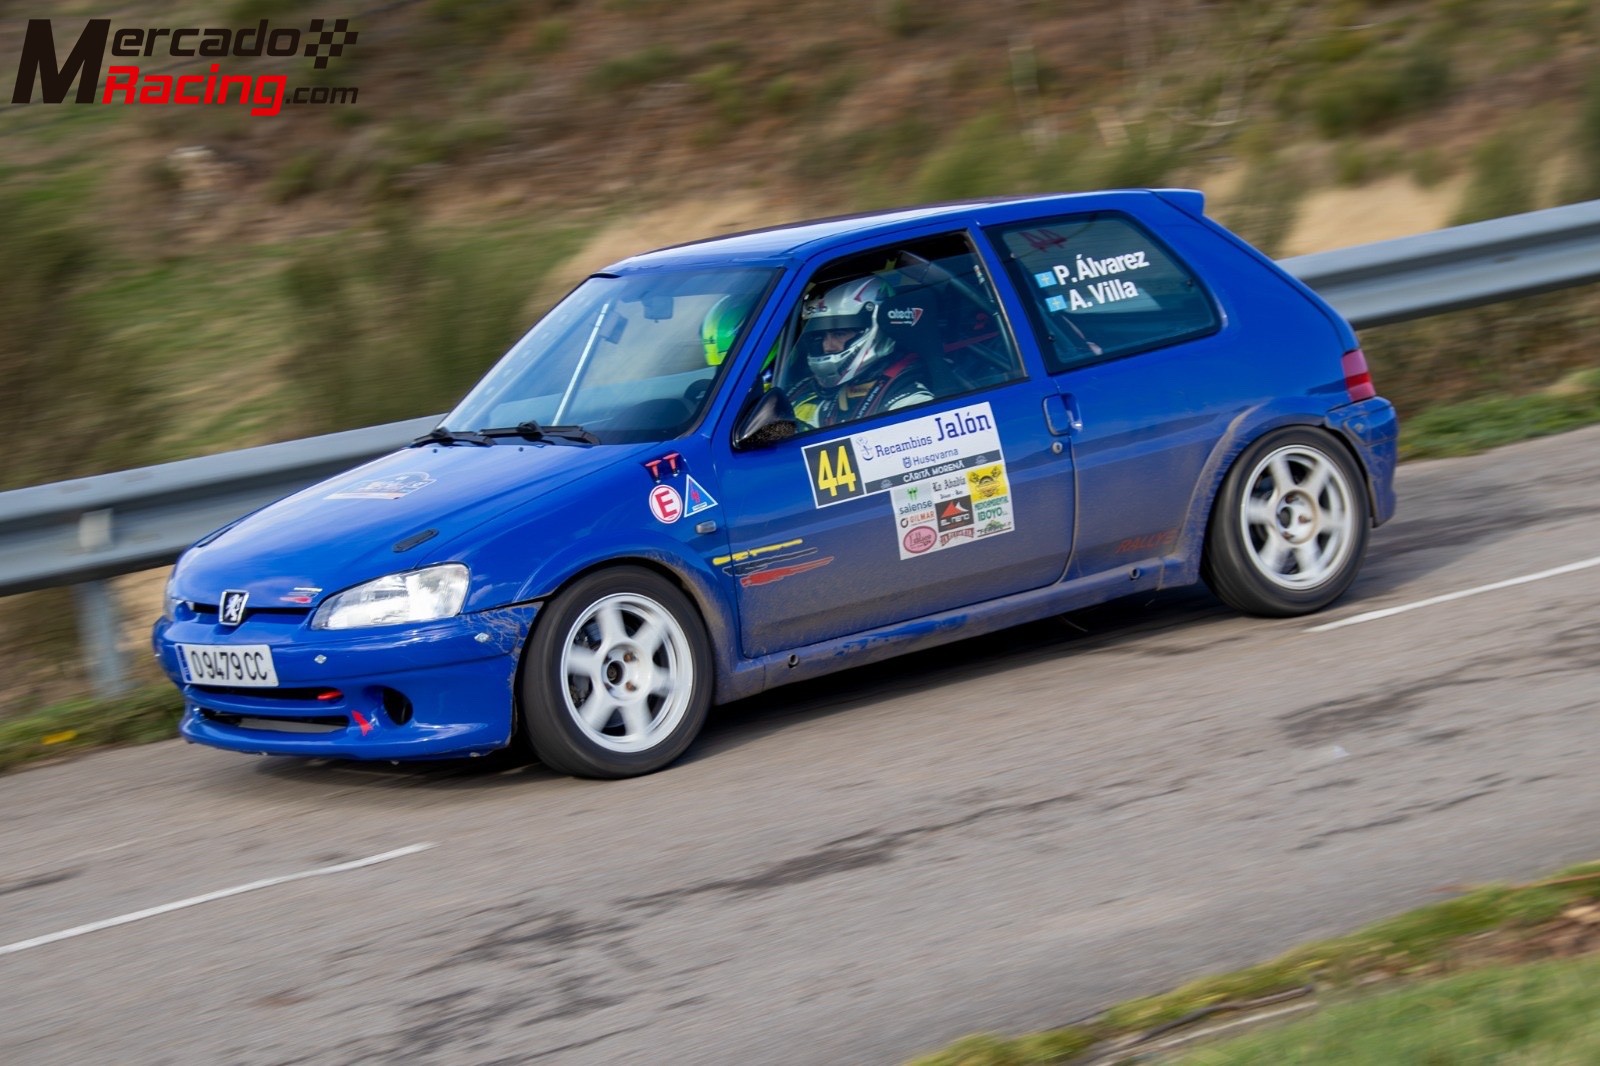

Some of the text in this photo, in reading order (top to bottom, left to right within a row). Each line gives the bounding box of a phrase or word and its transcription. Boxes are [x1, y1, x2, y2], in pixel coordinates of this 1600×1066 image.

[875, 412, 992, 458] Recambios Jalón
[818, 446, 857, 497] 44
[913, 448, 959, 467] Husqvarna
[655, 490, 677, 518] E
[899, 500, 933, 515] salense
